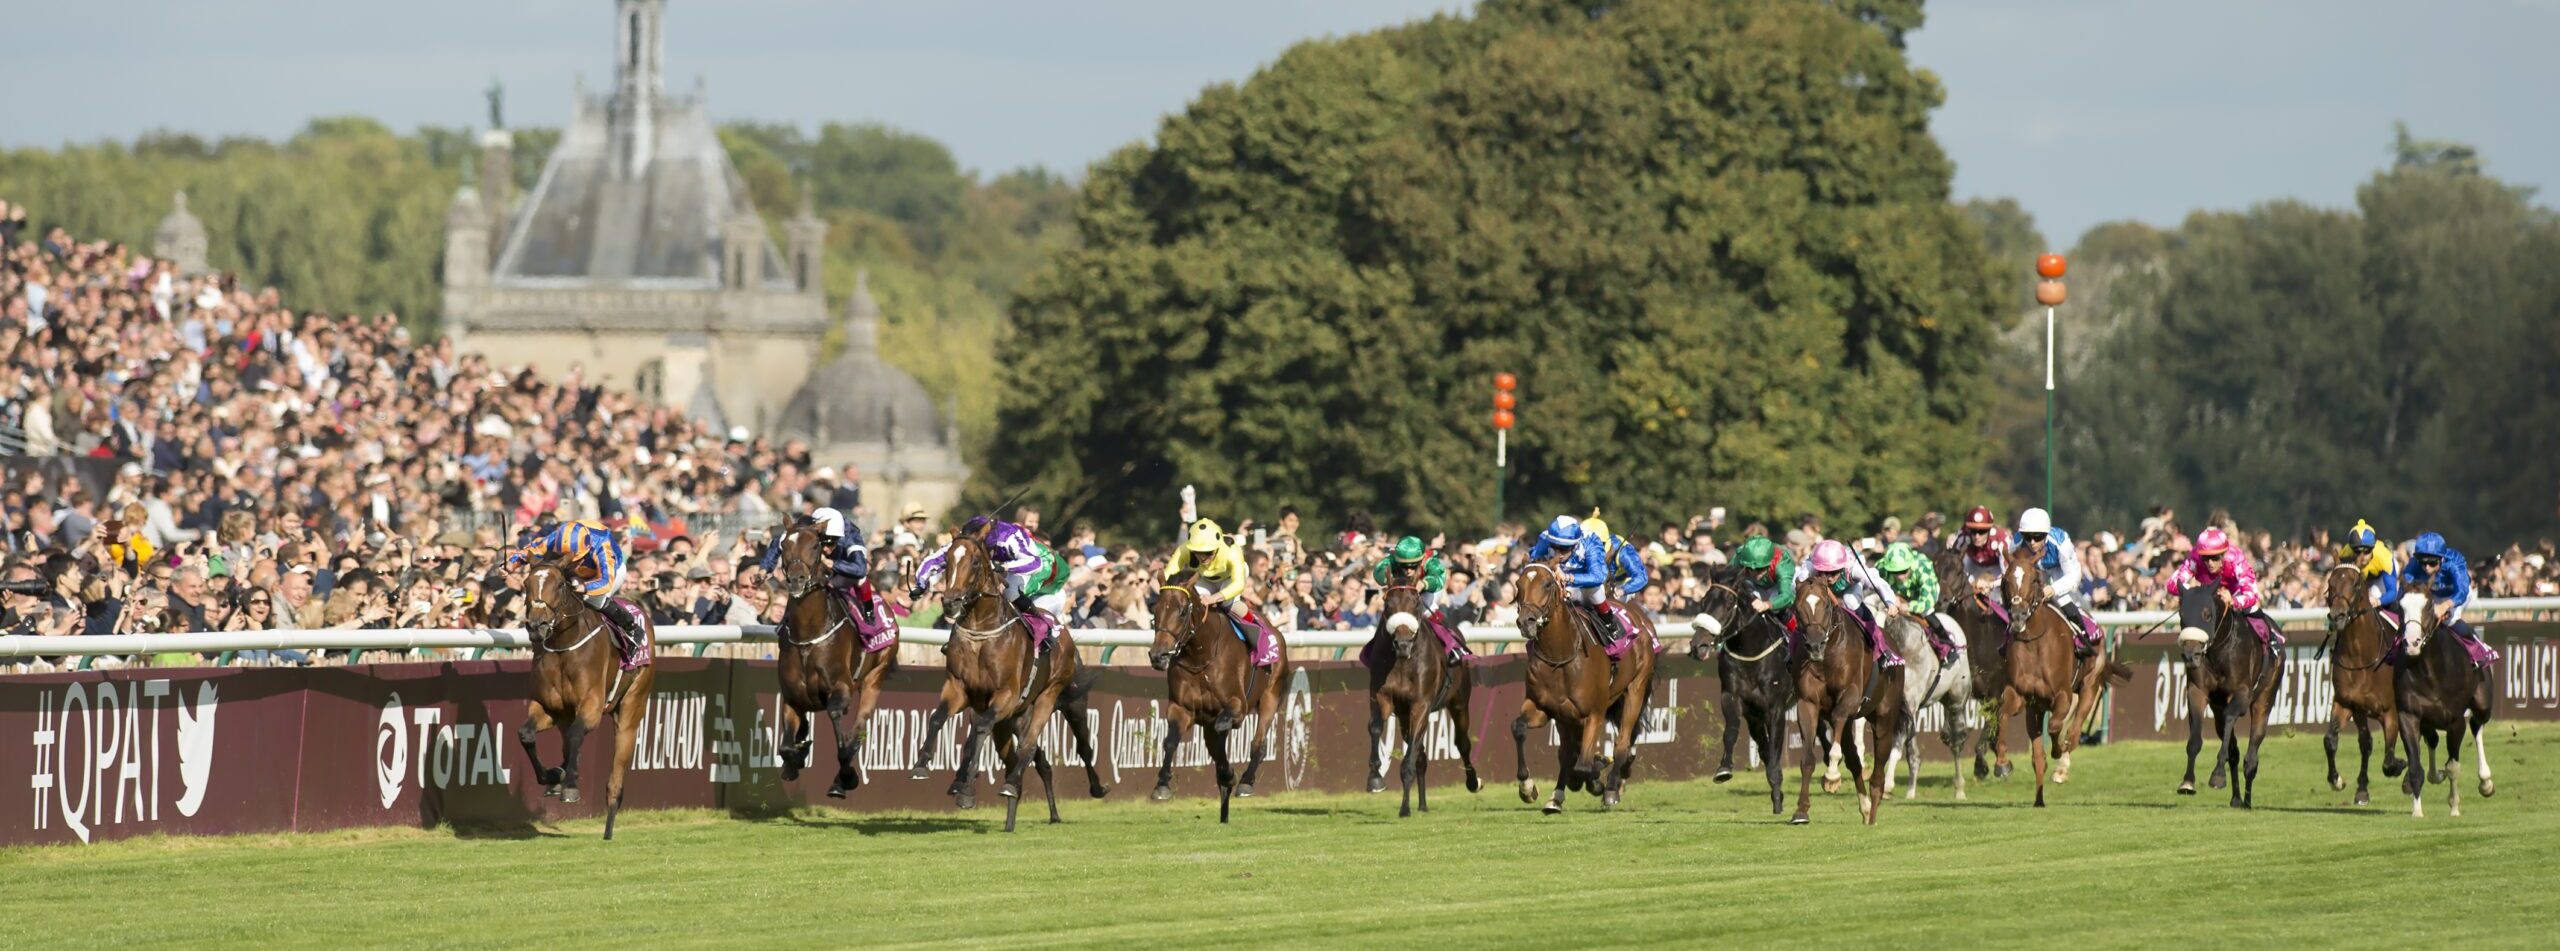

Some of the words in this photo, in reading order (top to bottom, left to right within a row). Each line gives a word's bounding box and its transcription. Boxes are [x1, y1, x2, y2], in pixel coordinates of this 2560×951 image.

[32, 679, 170, 845] #QPAT
[414, 708, 510, 790] TOTAL
[858, 708, 905, 784] QATAR
[1111, 700, 1147, 784] QATAR
